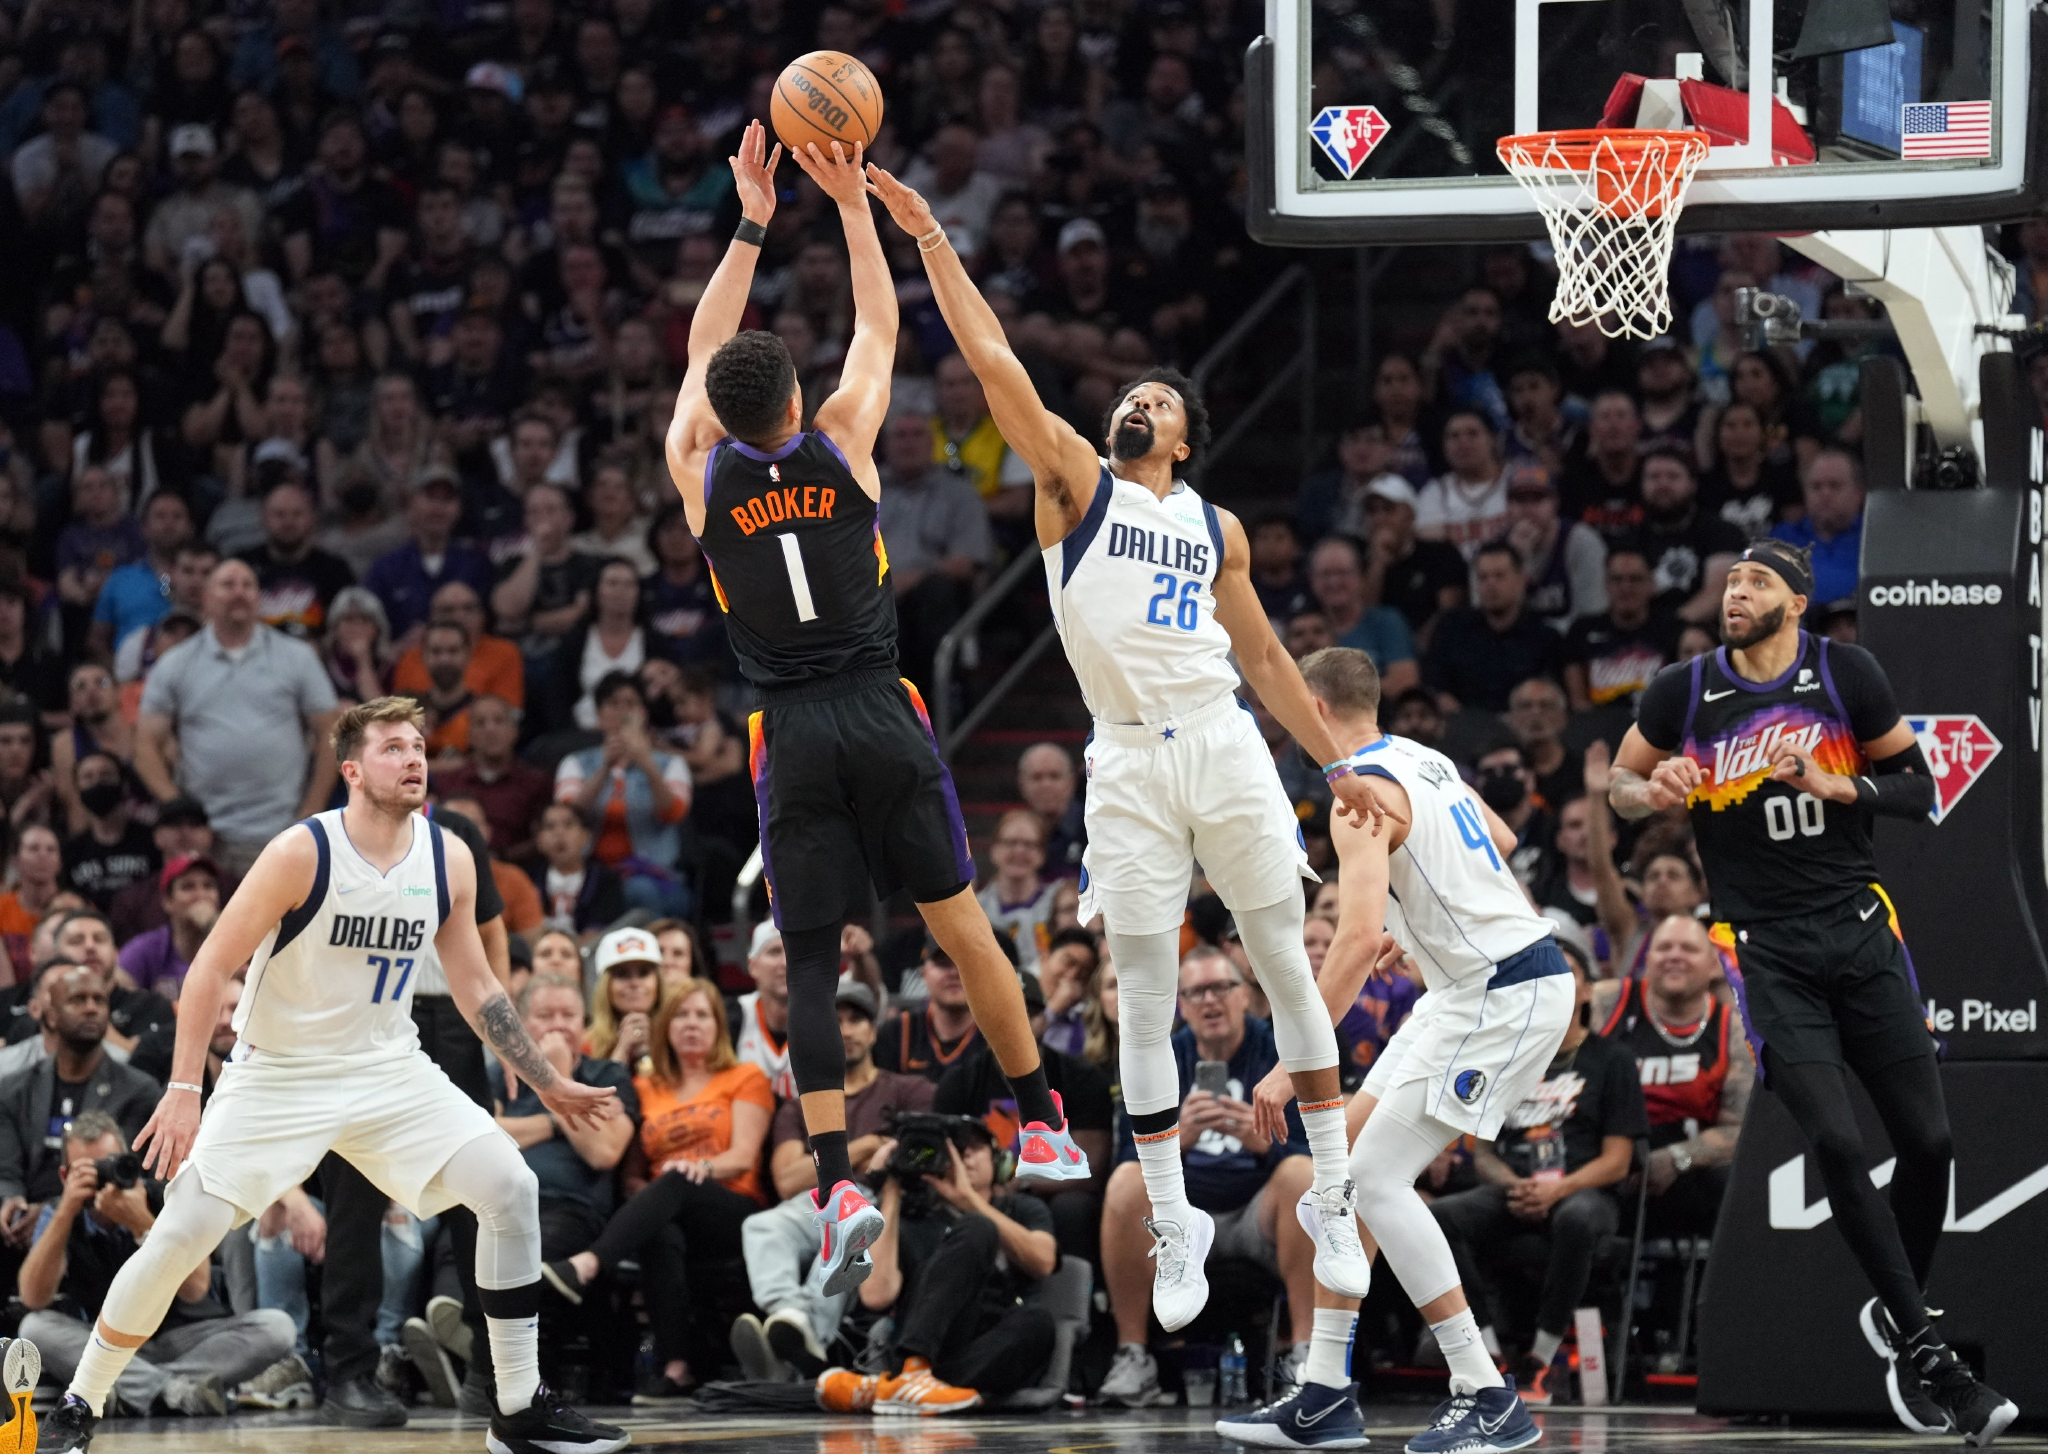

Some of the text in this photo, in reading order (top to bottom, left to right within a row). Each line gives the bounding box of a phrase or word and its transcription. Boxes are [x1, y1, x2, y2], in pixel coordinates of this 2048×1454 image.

[791, 71, 849, 133] Wilson
[1355, 116, 1373, 138] 75
[730, 486, 836, 537] BOOKER
[1174, 512, 1204, 527] chime
[1107, 522, 1209, 576] DALLAS
[775, 532, 820, 623] 1
[1869, 578, 2003, 606] coinbase
[1147, 573, 1203, 631] 26
[1793, 682, 1820, 694] PayPal
[1714, 721, 1823, 786] Vally
[1738, 734, 1760, 750] THE
[1949, 731, 1974, 764] 75
[1763, 791, 1826, 842] 00
[402, 884, 432, 897] chime
[329, 914, 426, 952] DALLAS
[367, 954, 414, 1004] 77
[1962, 998, 2037, 1033] Pixel
